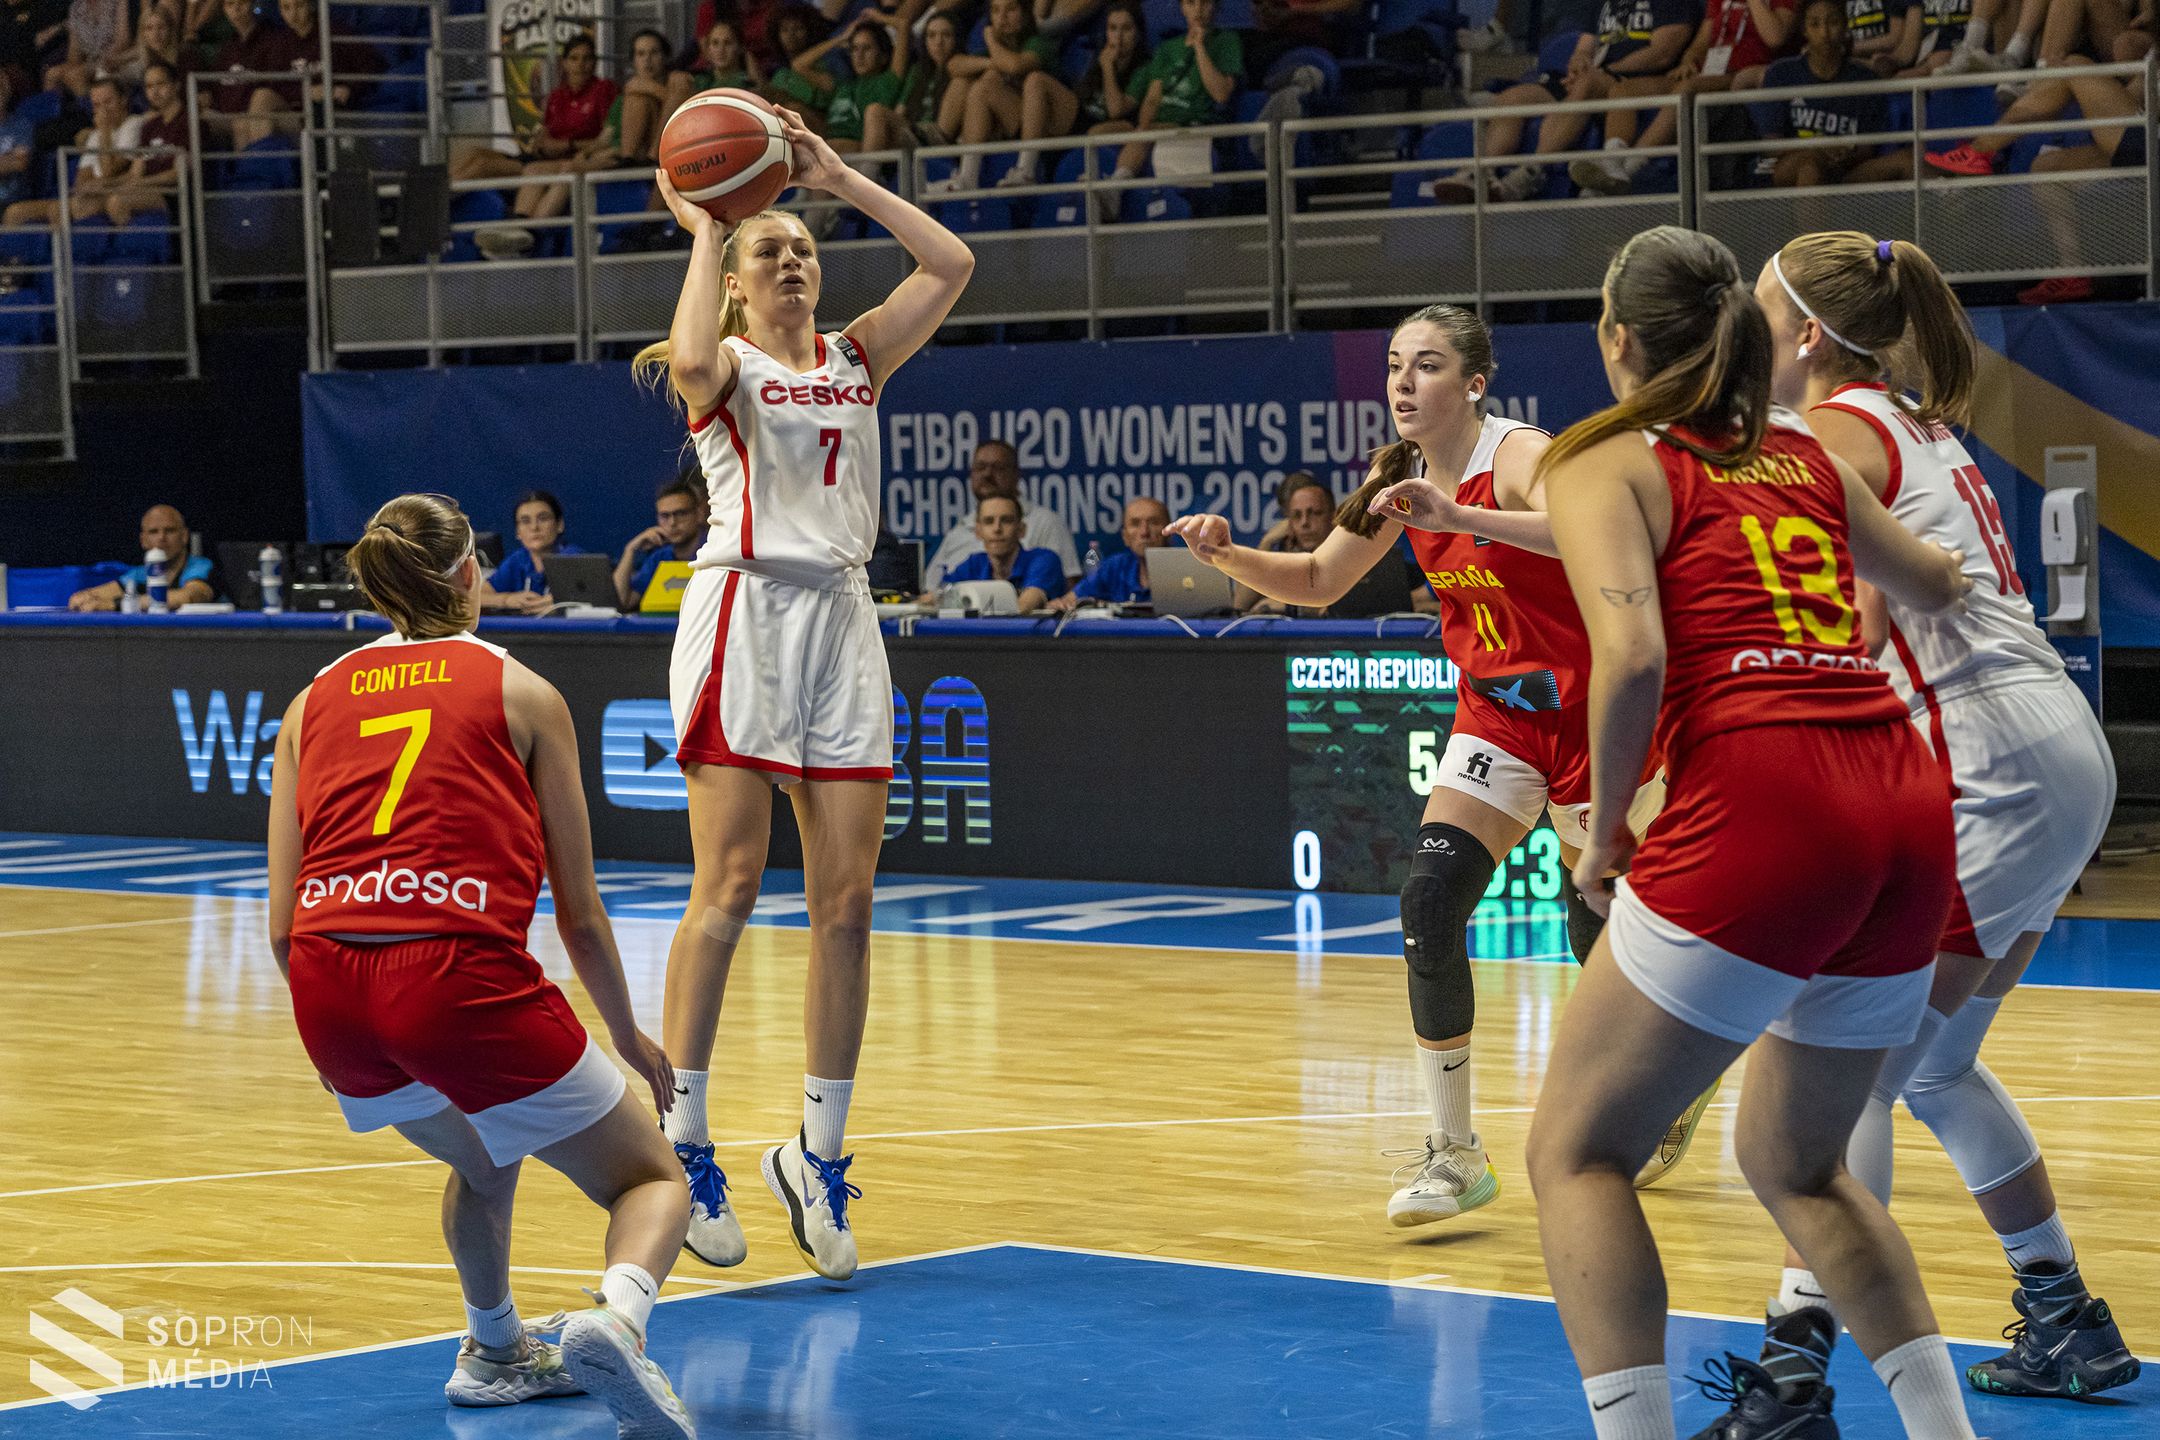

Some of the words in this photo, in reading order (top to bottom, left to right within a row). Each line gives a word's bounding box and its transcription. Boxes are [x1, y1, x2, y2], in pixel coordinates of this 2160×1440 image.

[1790, 107, 1858, 135] SWEDEN
[674, 151, 727, 177] molten
[760, 380, 875, 406] ČESKO
[819, 428, 842, 486] 7
[889, 411, 979, 472] FIBA
[1080, 401, 1288, 468] WOMEN'S
[1203, 469, 1314, 536] 202
[1425, 565, 1505, 589] SPAÑA
[1739, 515, 1854, 646] 13
[1473, 604, 1507, 652] 11
[351, 660, 452, 695] CONTELL
[1291, 657, 1360, 689] CZECH
[360, 709, 432, 836] 7
[1457, 772, 1491, 789] network
[1467, 752, 1494, 779] fi
[1293, 830, 1321, 890] 0
[301, 859, 488, 912] endesa
